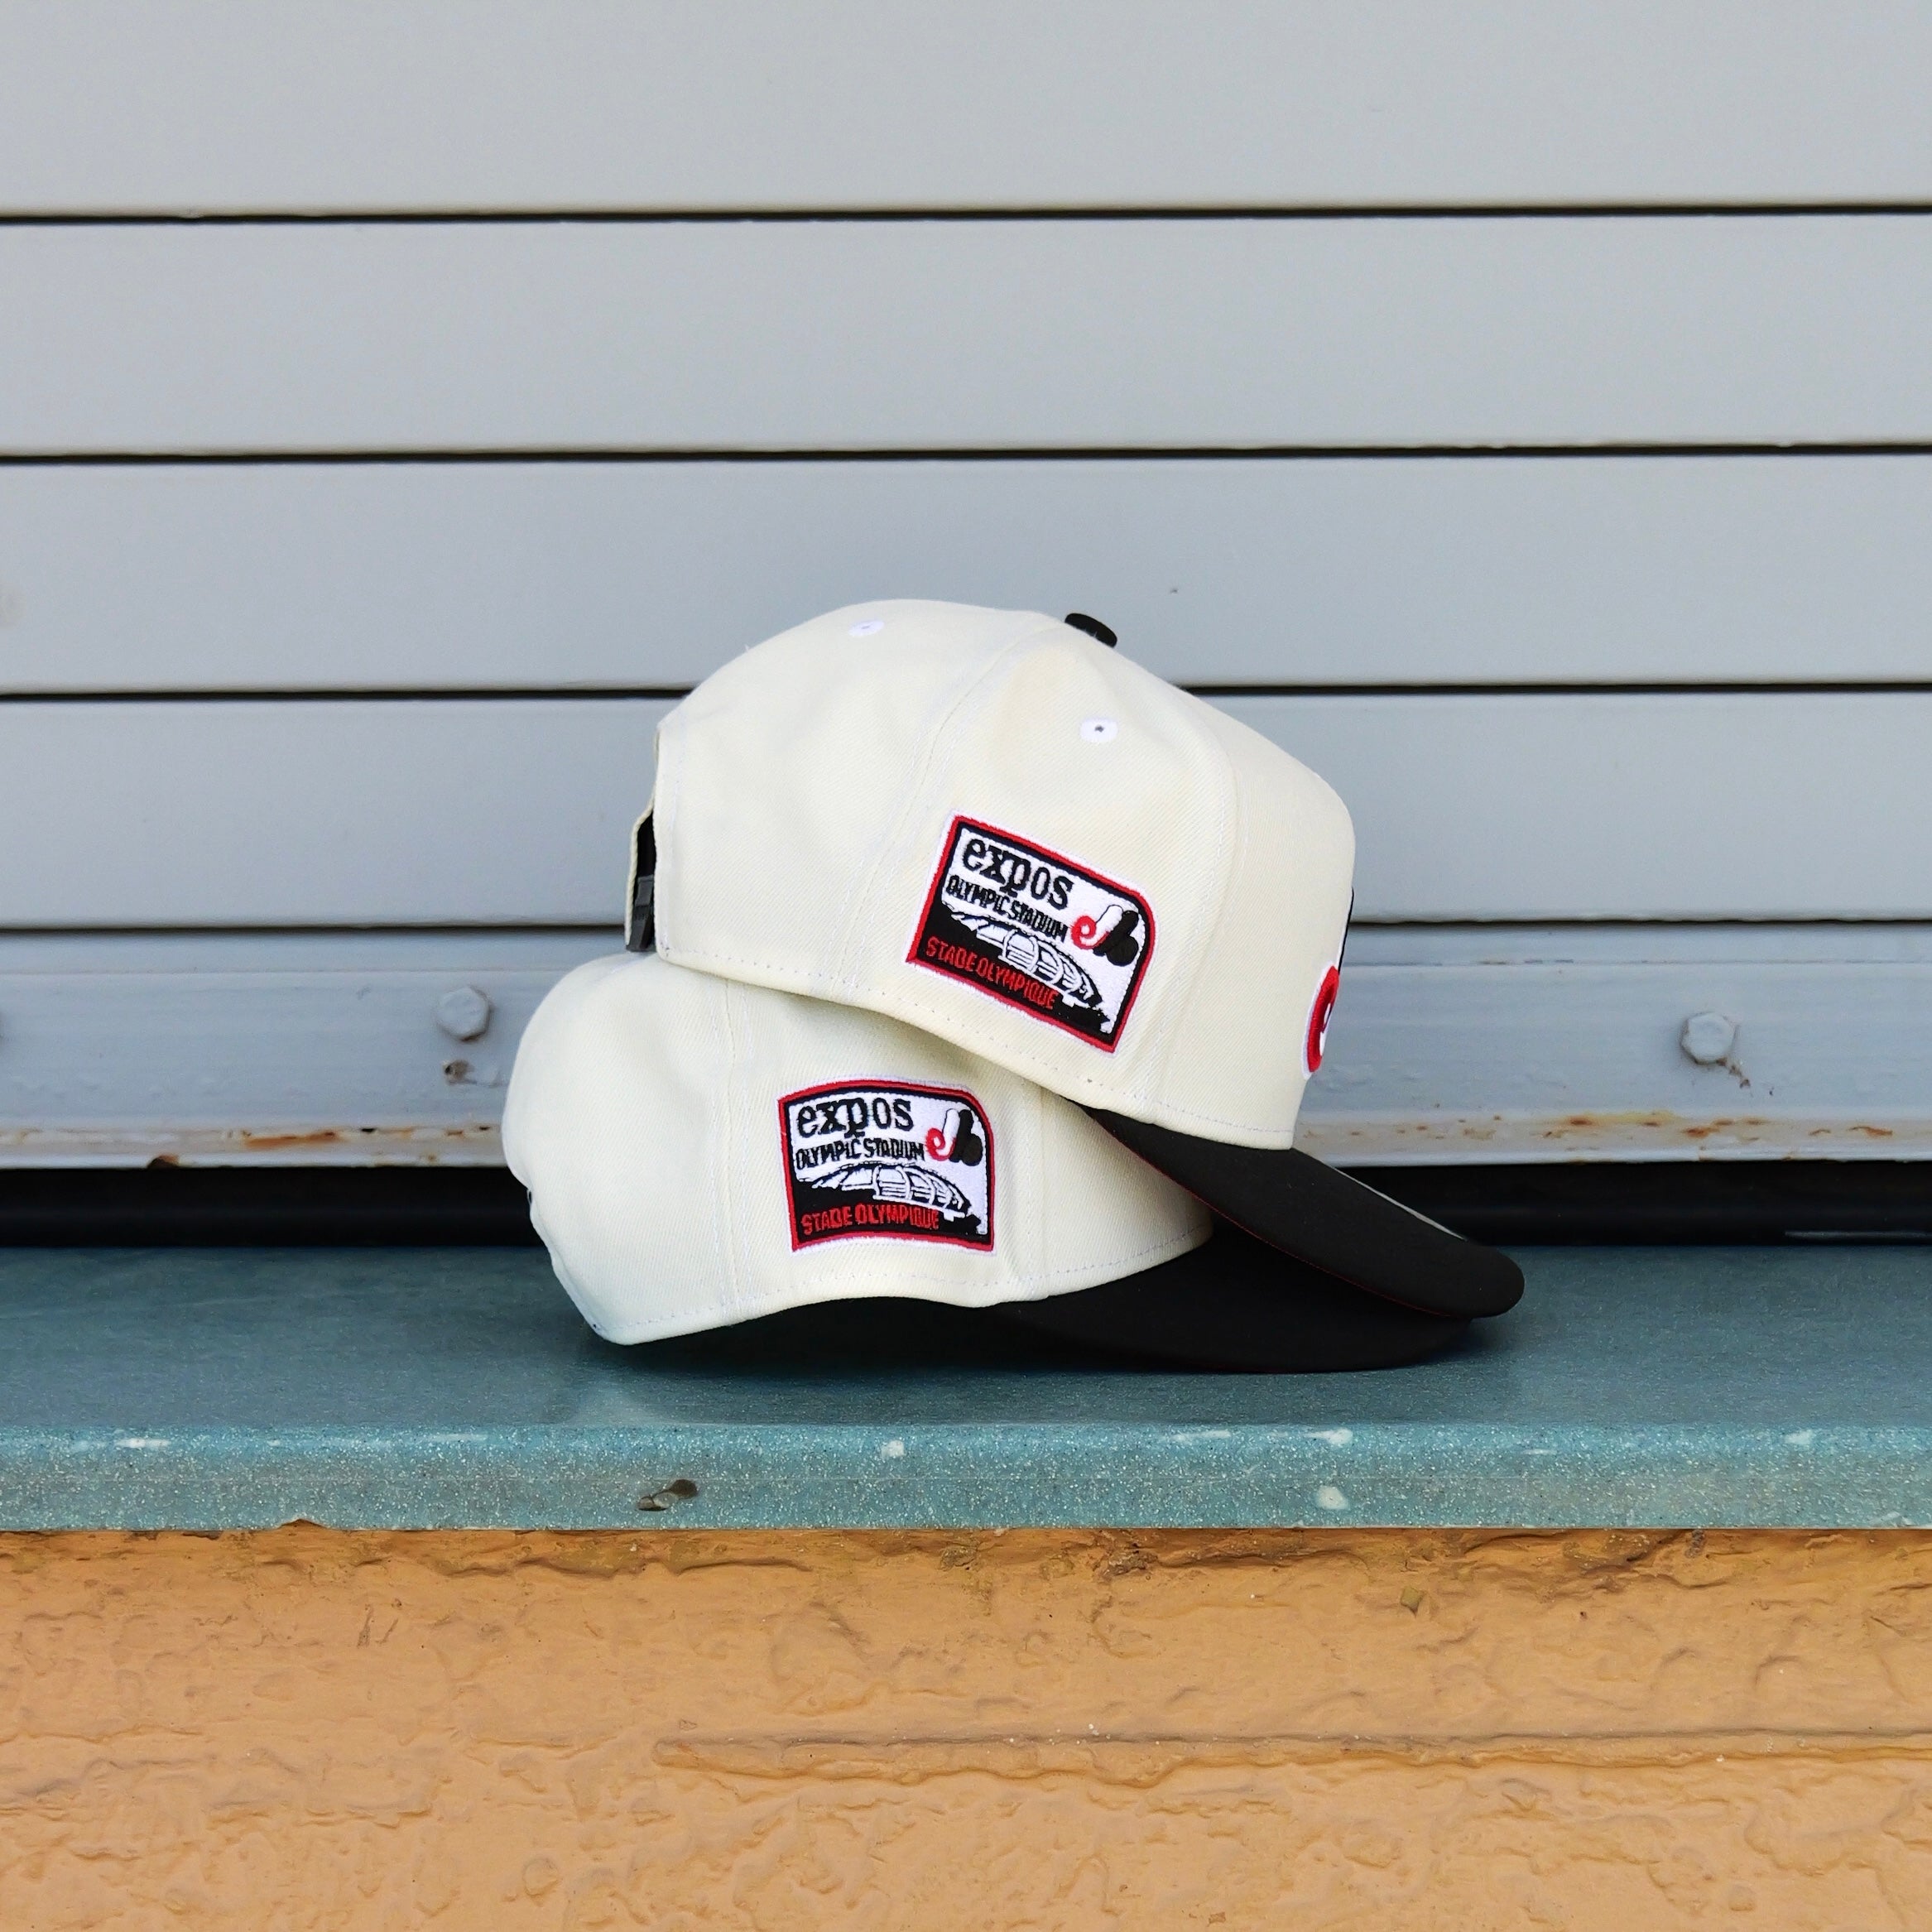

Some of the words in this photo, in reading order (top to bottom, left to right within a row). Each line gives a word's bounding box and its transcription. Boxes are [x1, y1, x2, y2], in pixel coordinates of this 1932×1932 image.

[962, 839, 1074, 911] expos
[945, 875, 1011, 916] OLYMPIC
[1008, 902, 1069, 943] STADIUM
[926, 936, 976, 972] STADE
[976, 958, 1058, 1010] OLYMPIQUE
[796, 1098, 914, 1138] expos
[795, 1138, 862, 1170] OLYMPIC
[863, 1137, 925, 1161] STADIUM
[800, 1205, 853, 1235] STADE
[854, 1203, 939, 1229] OLYMPIQUE
